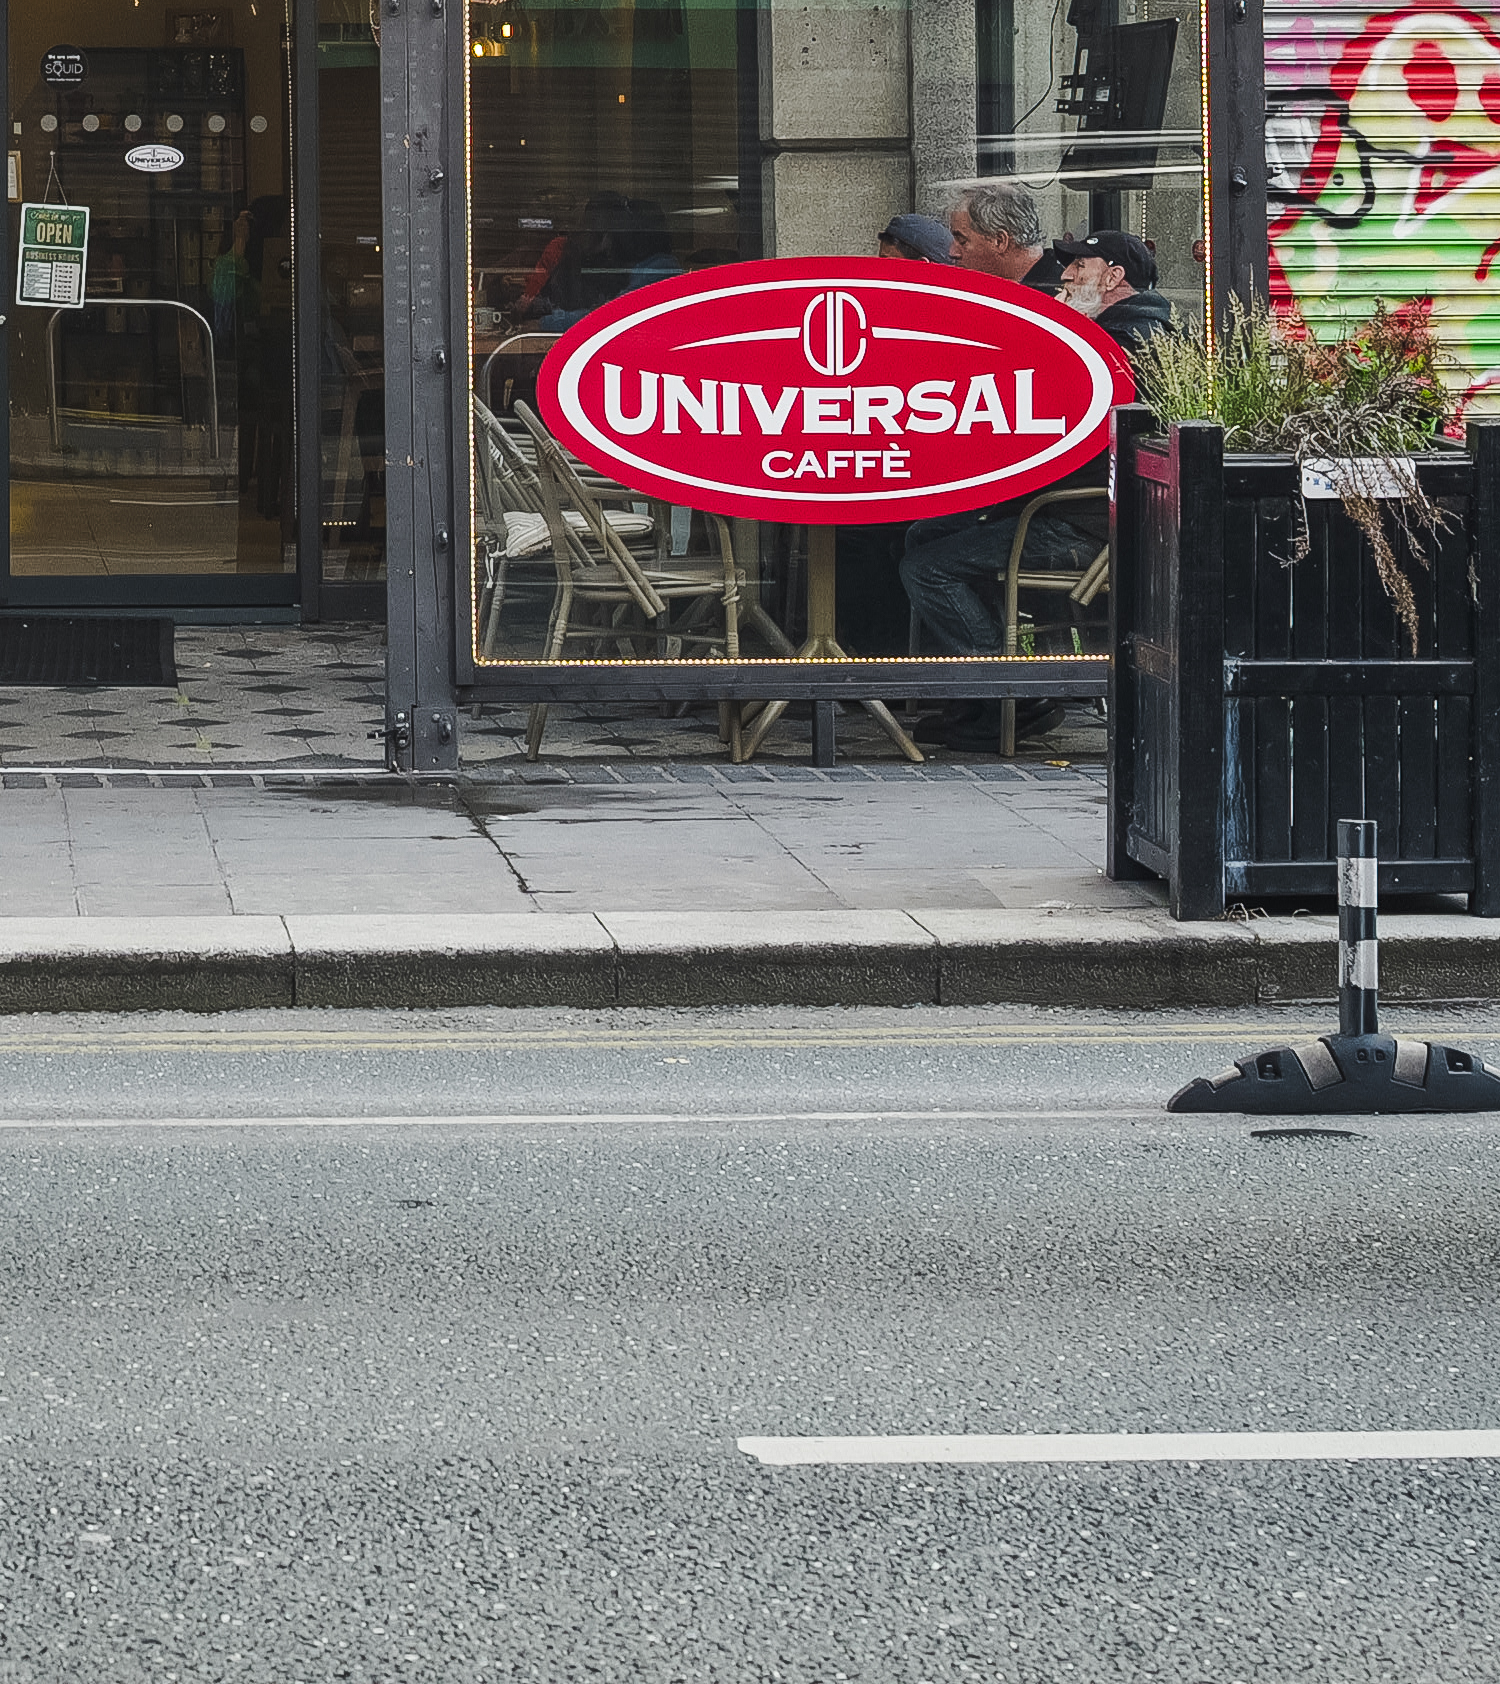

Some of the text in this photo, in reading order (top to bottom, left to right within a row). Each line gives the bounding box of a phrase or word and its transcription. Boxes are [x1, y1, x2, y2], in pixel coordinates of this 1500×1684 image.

[45, 61, 84, 77] SQUID
[36, 221, 73, 245] OPEN
[602, 362, 1067, 437] UNIVERSAL
[760, 443, 913, 480] CAFFÈ
